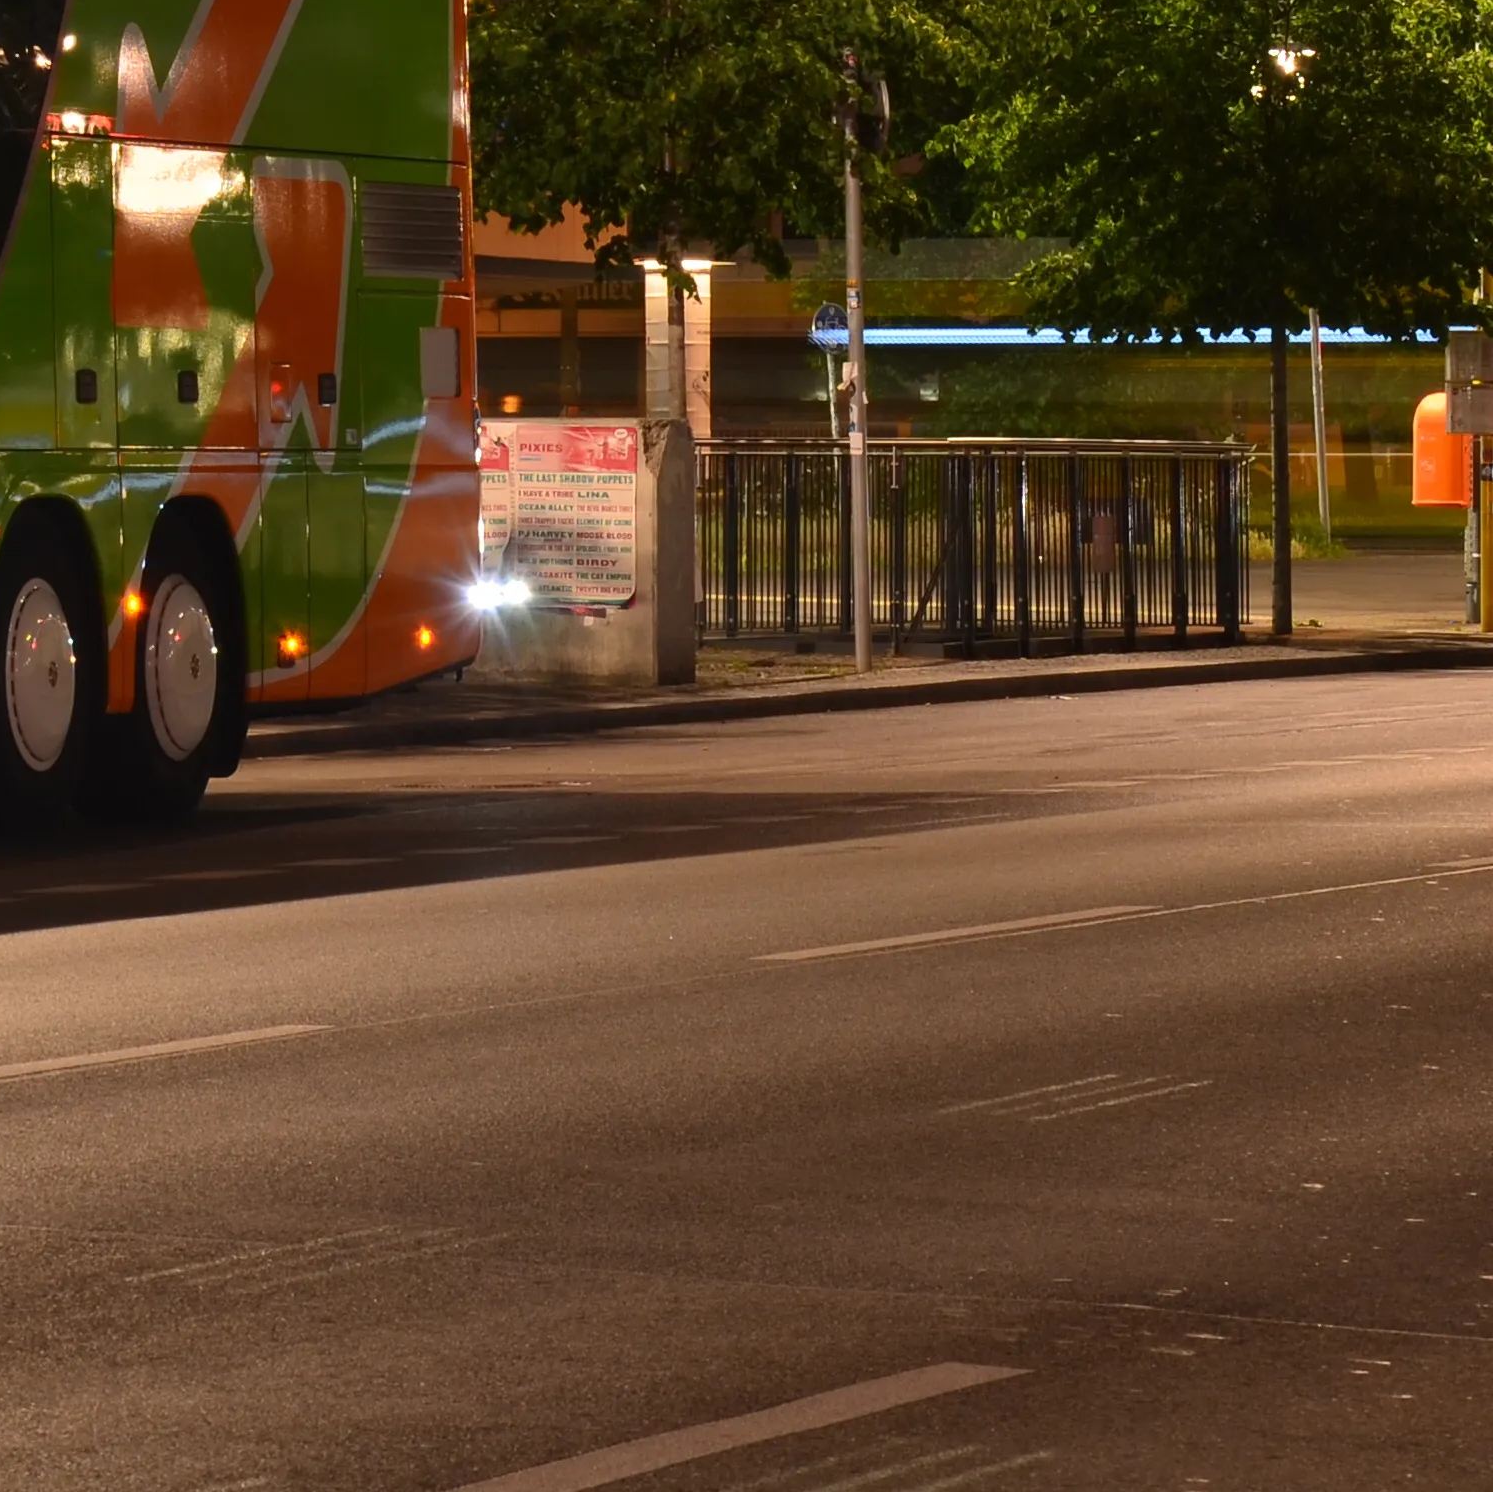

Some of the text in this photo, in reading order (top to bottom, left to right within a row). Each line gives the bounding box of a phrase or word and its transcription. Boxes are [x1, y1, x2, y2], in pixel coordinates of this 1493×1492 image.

[519, 443, 564, 453] PIXIES
[518, 473, 633, 485] THE LAST SHADOW PUPPETS
[577, 491, 610, 499] LINA
[548, 504, 574, 512] ALLEY
[532, 530, 574, 538] HARVEY
[606, 532, 633, 540] BLOOD
[576, 559, 618, 567] BIRDY
[576, 572, 589, 580] THE
[606, 573, 632, 581] EMPIRE
